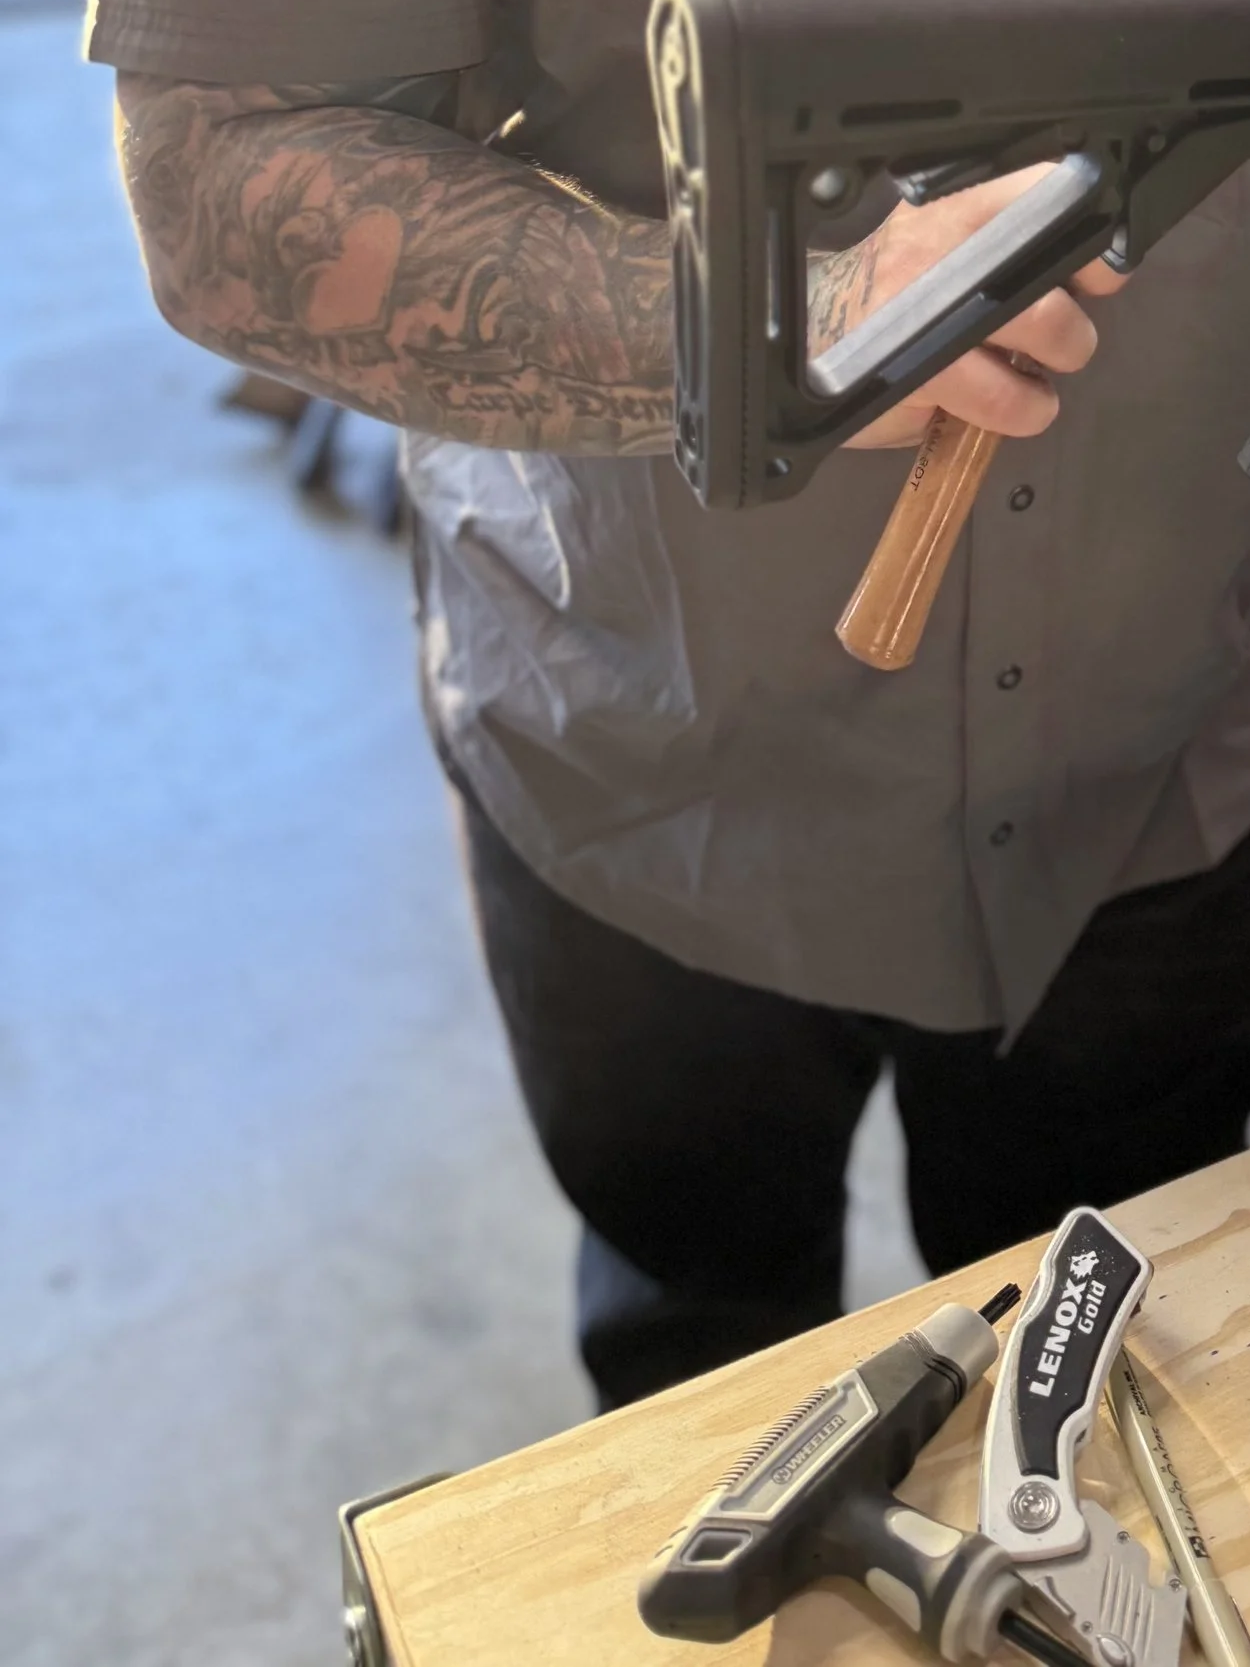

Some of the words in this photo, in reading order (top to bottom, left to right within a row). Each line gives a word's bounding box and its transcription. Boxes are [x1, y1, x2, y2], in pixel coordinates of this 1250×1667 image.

[1078, 1280, 1106, 1334] Gold
[1029, 1278, 1087, 1397] LENOX
[785, 1416, 846, 1470] WHEELER
